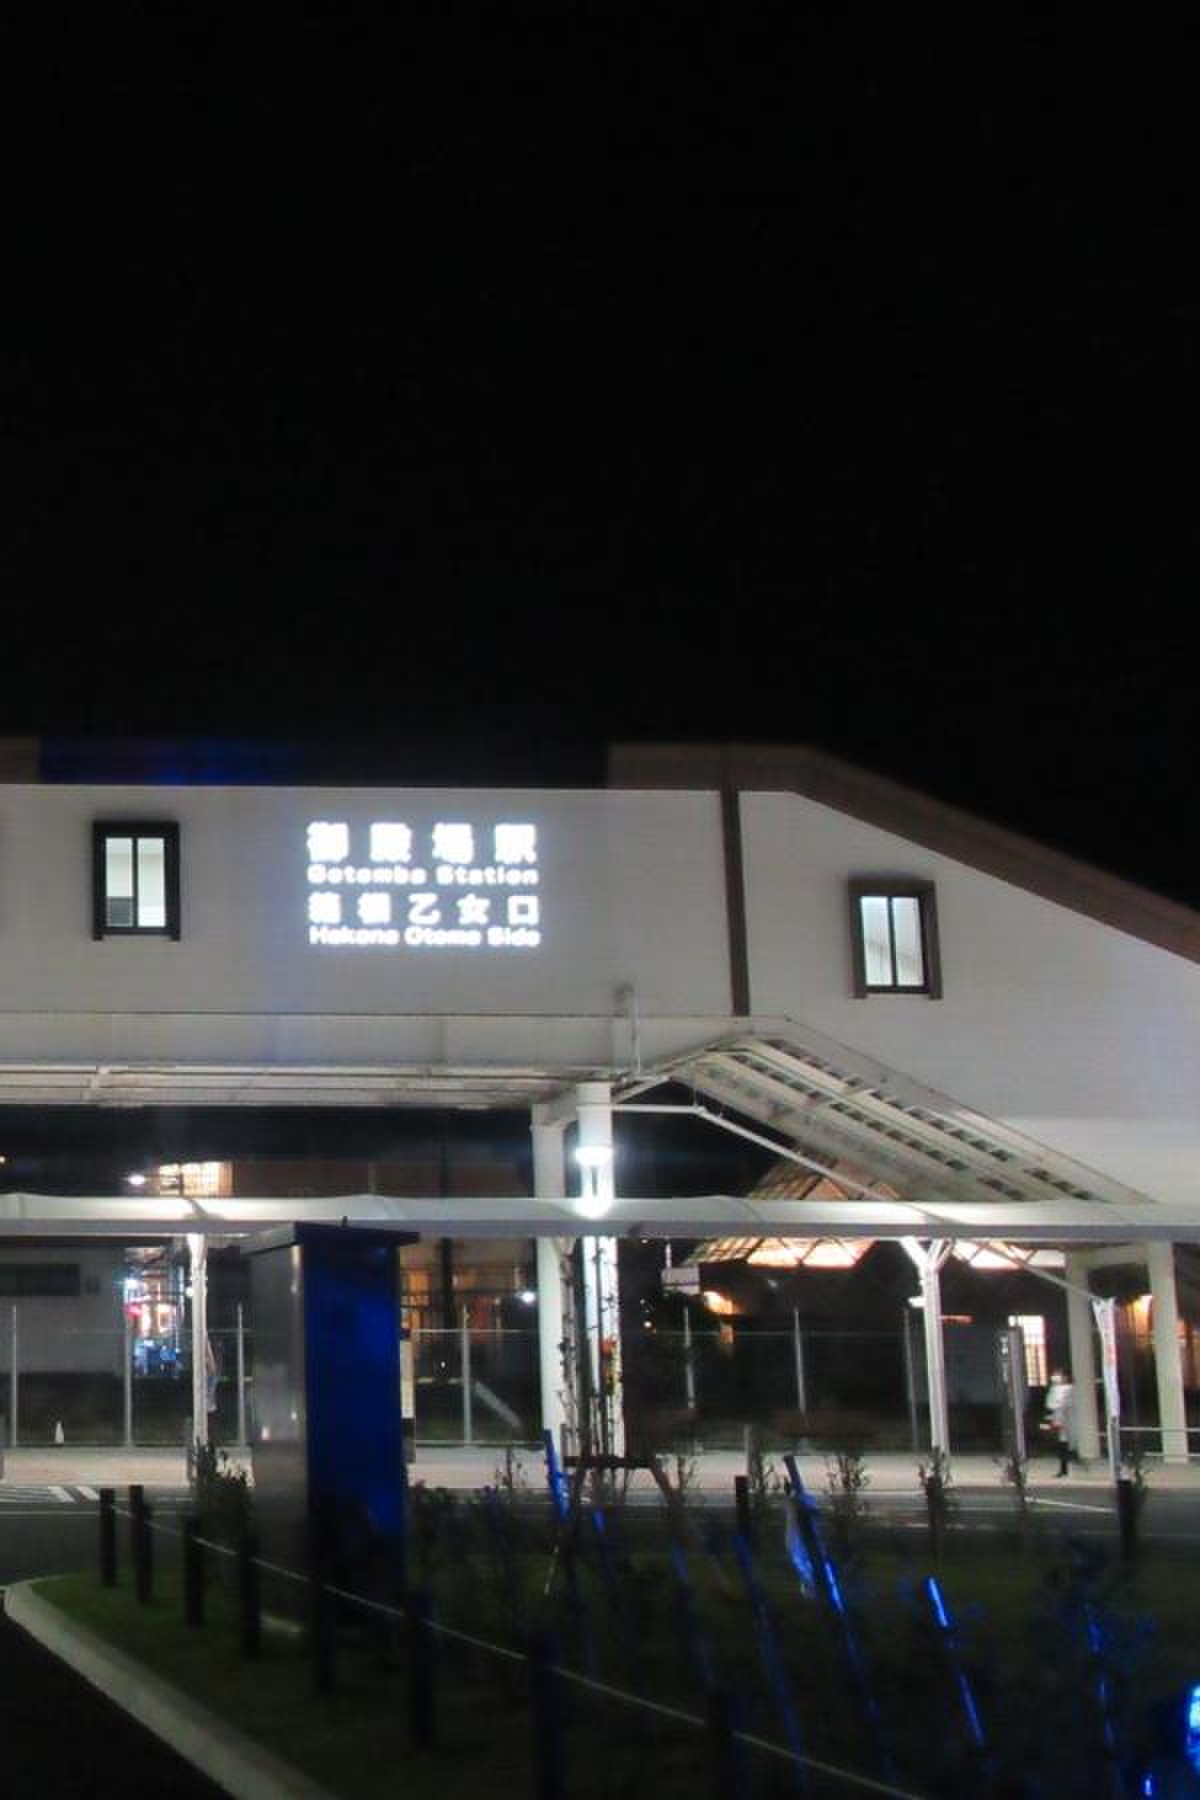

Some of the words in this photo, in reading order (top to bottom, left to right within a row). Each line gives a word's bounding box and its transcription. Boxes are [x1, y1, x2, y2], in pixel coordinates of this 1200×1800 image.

[436, 865, 539, 886] Station
[309, 925, 400, 946] Hakone
[487, 926, 541, 947] Side
